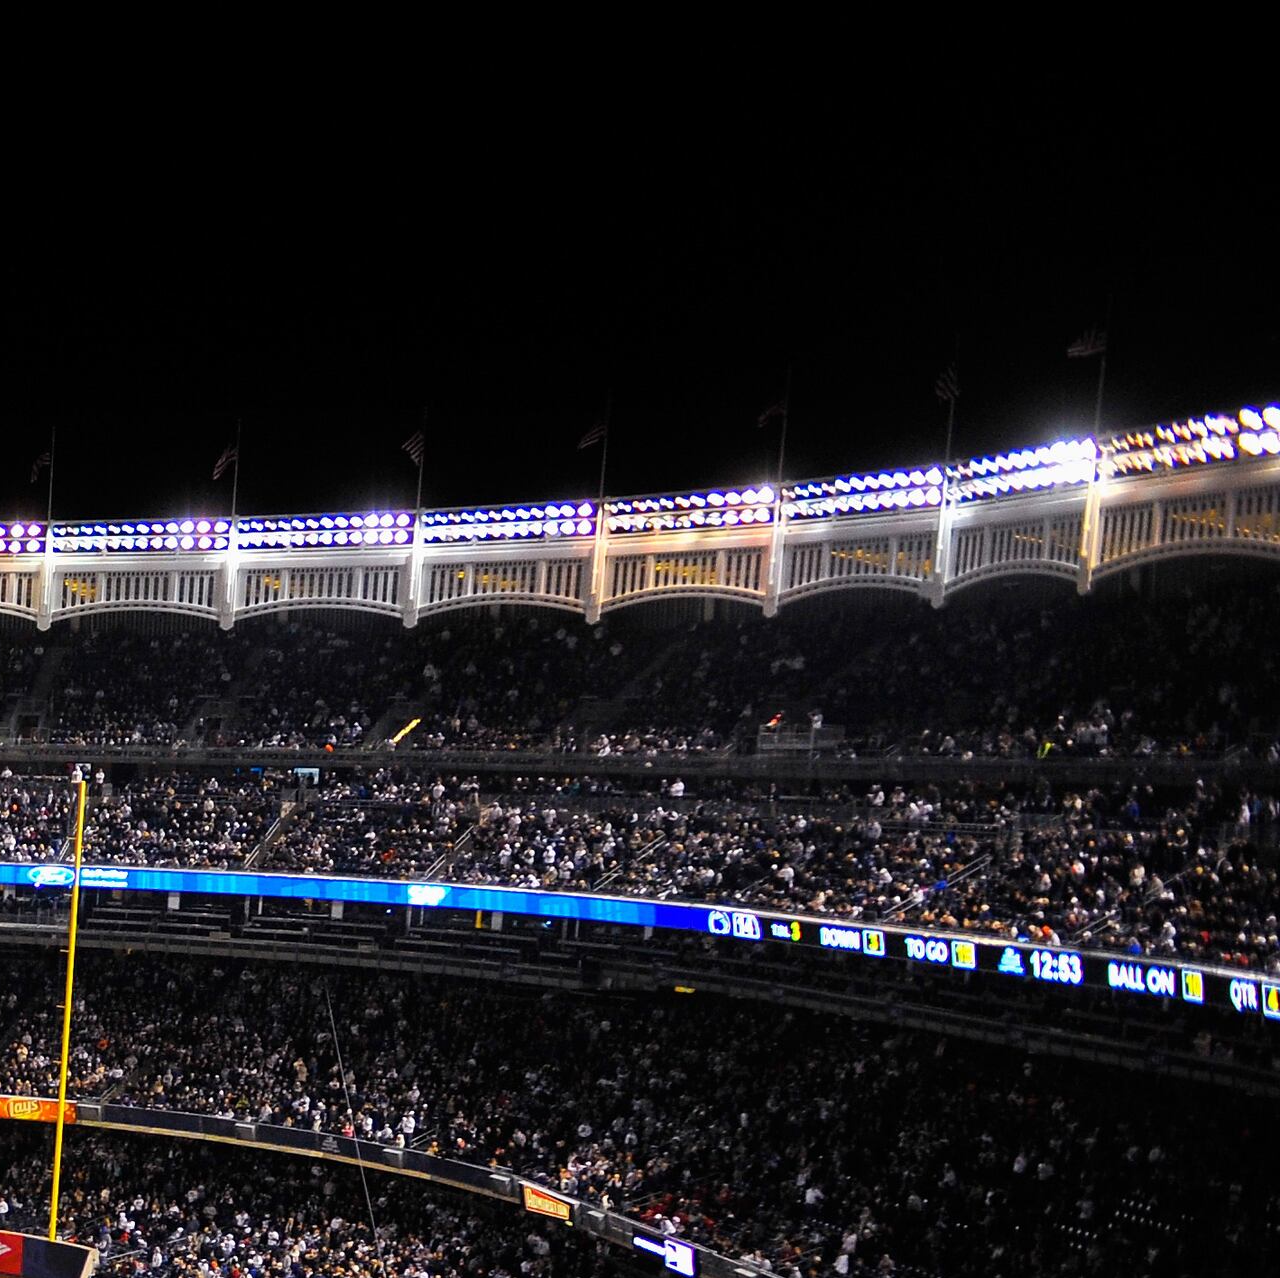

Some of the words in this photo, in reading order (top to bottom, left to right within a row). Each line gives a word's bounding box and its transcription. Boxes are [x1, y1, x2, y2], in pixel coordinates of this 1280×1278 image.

[820, 927, 861, 950] DOWN
[904, 937, 925, 959] TO
[925, 940, 948, 962] GO
[1029, 950, 1083, 984] 12:53
[1108, 962, 1145, 992] BALL
[1146, 967, 1175, 995] ON
[1229, 979, 1258, 1012] QTR
